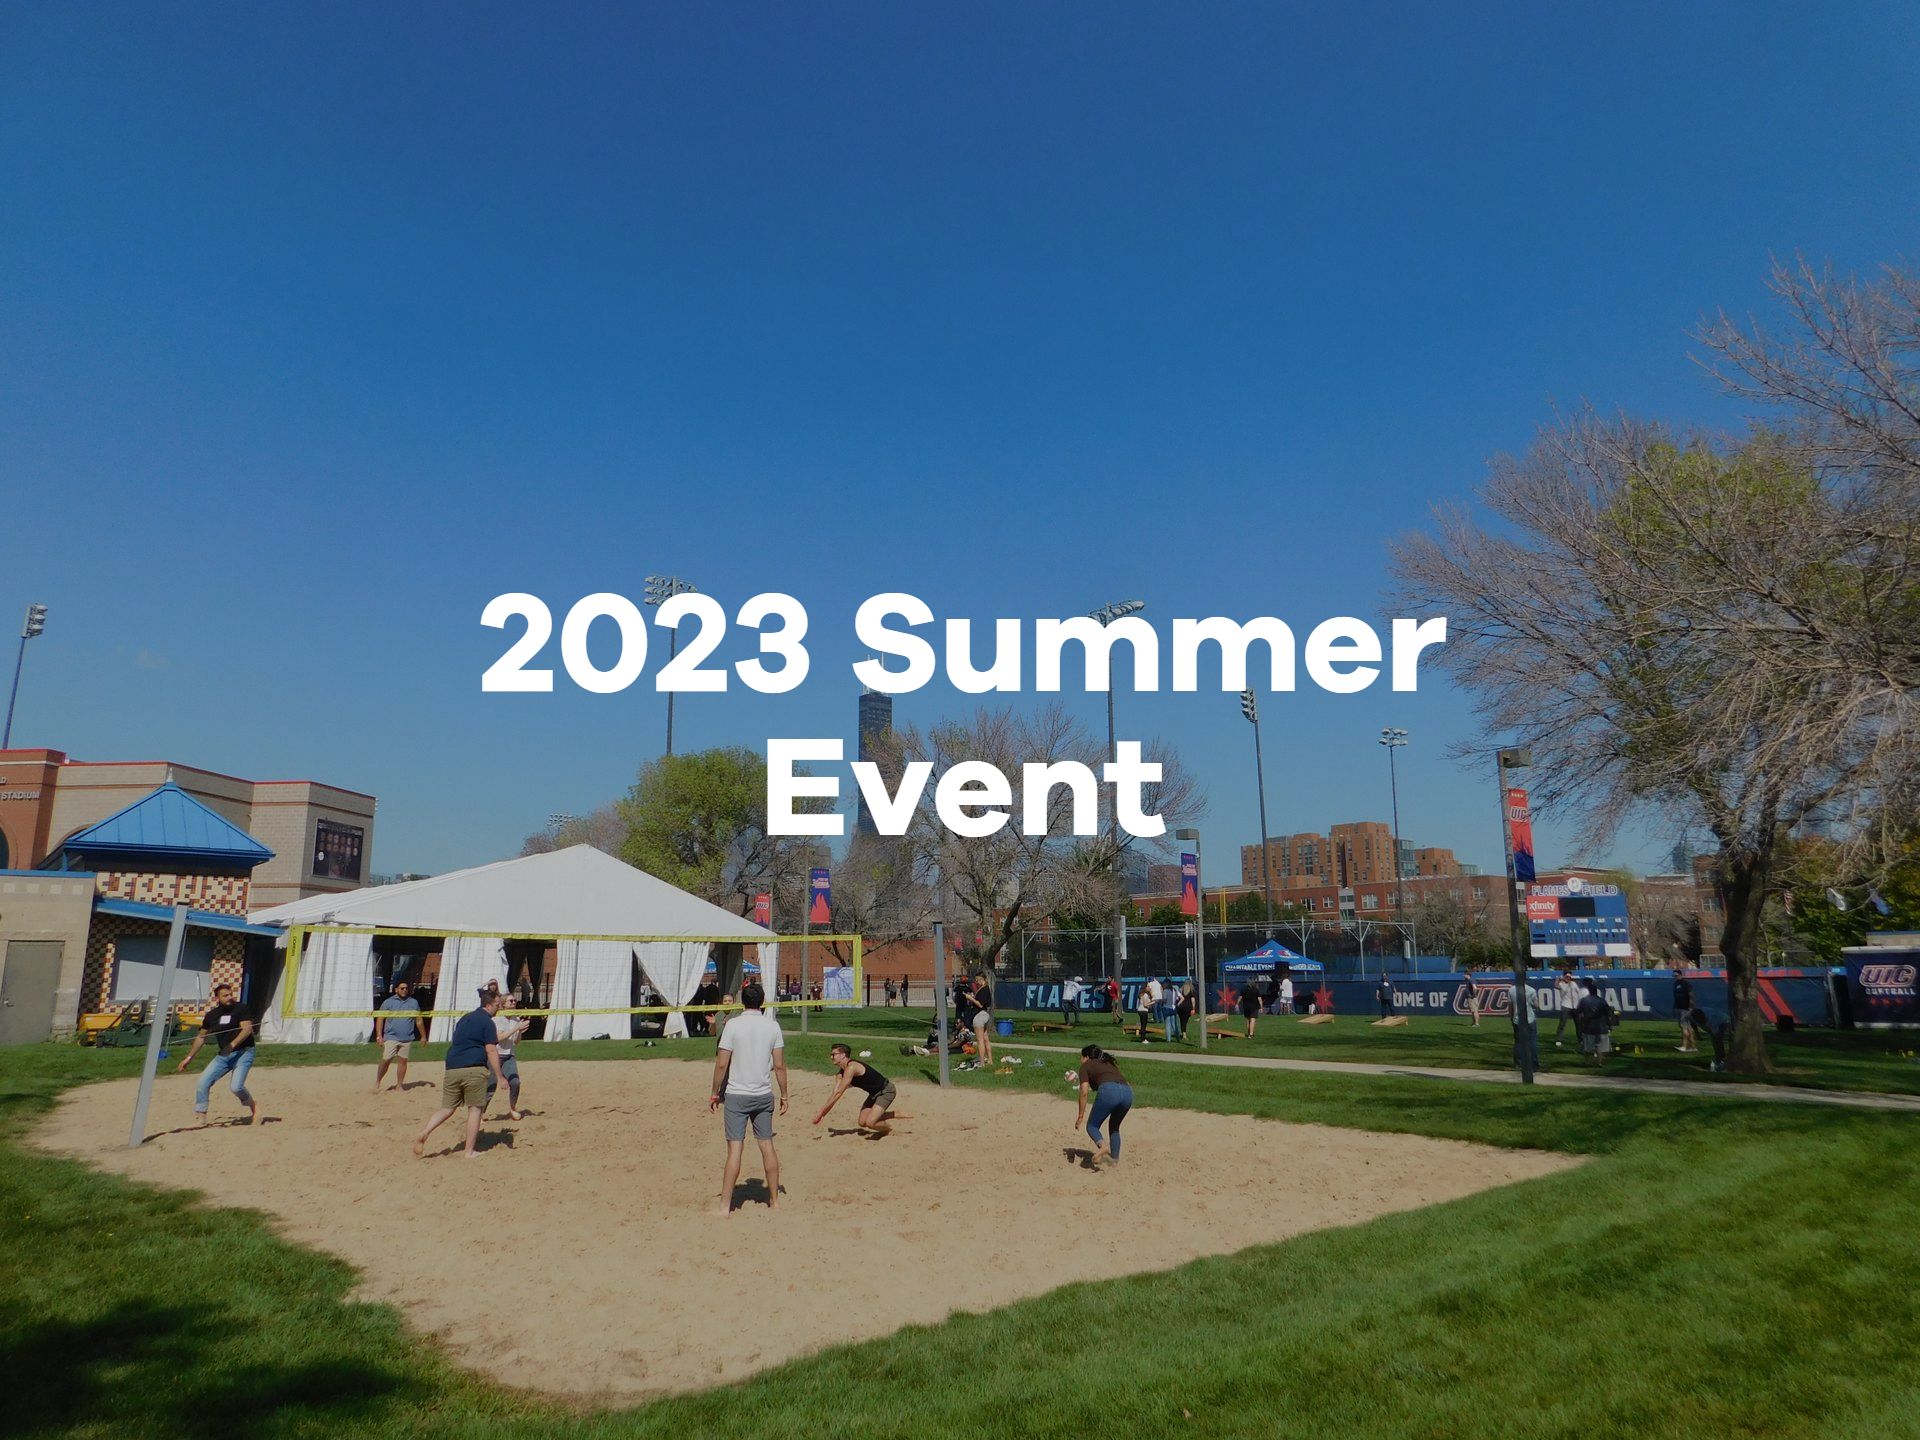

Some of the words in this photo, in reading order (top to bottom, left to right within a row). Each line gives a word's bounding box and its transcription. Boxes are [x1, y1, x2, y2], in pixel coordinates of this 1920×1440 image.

[2, 791, 40, 800] STADIUM
[1510, 806, 1528, 822] UIC
[1531, 884, 1570, 896] FLAMES
[1581, 884, 1618, 896] FIELD
[1529, 901, 1556, 911] xfinity
[1859, 965, 1916, 987] UIC
[1025, 985, 1105, 1009] FLAES
[1429, 992, 1448, 1007] OF
